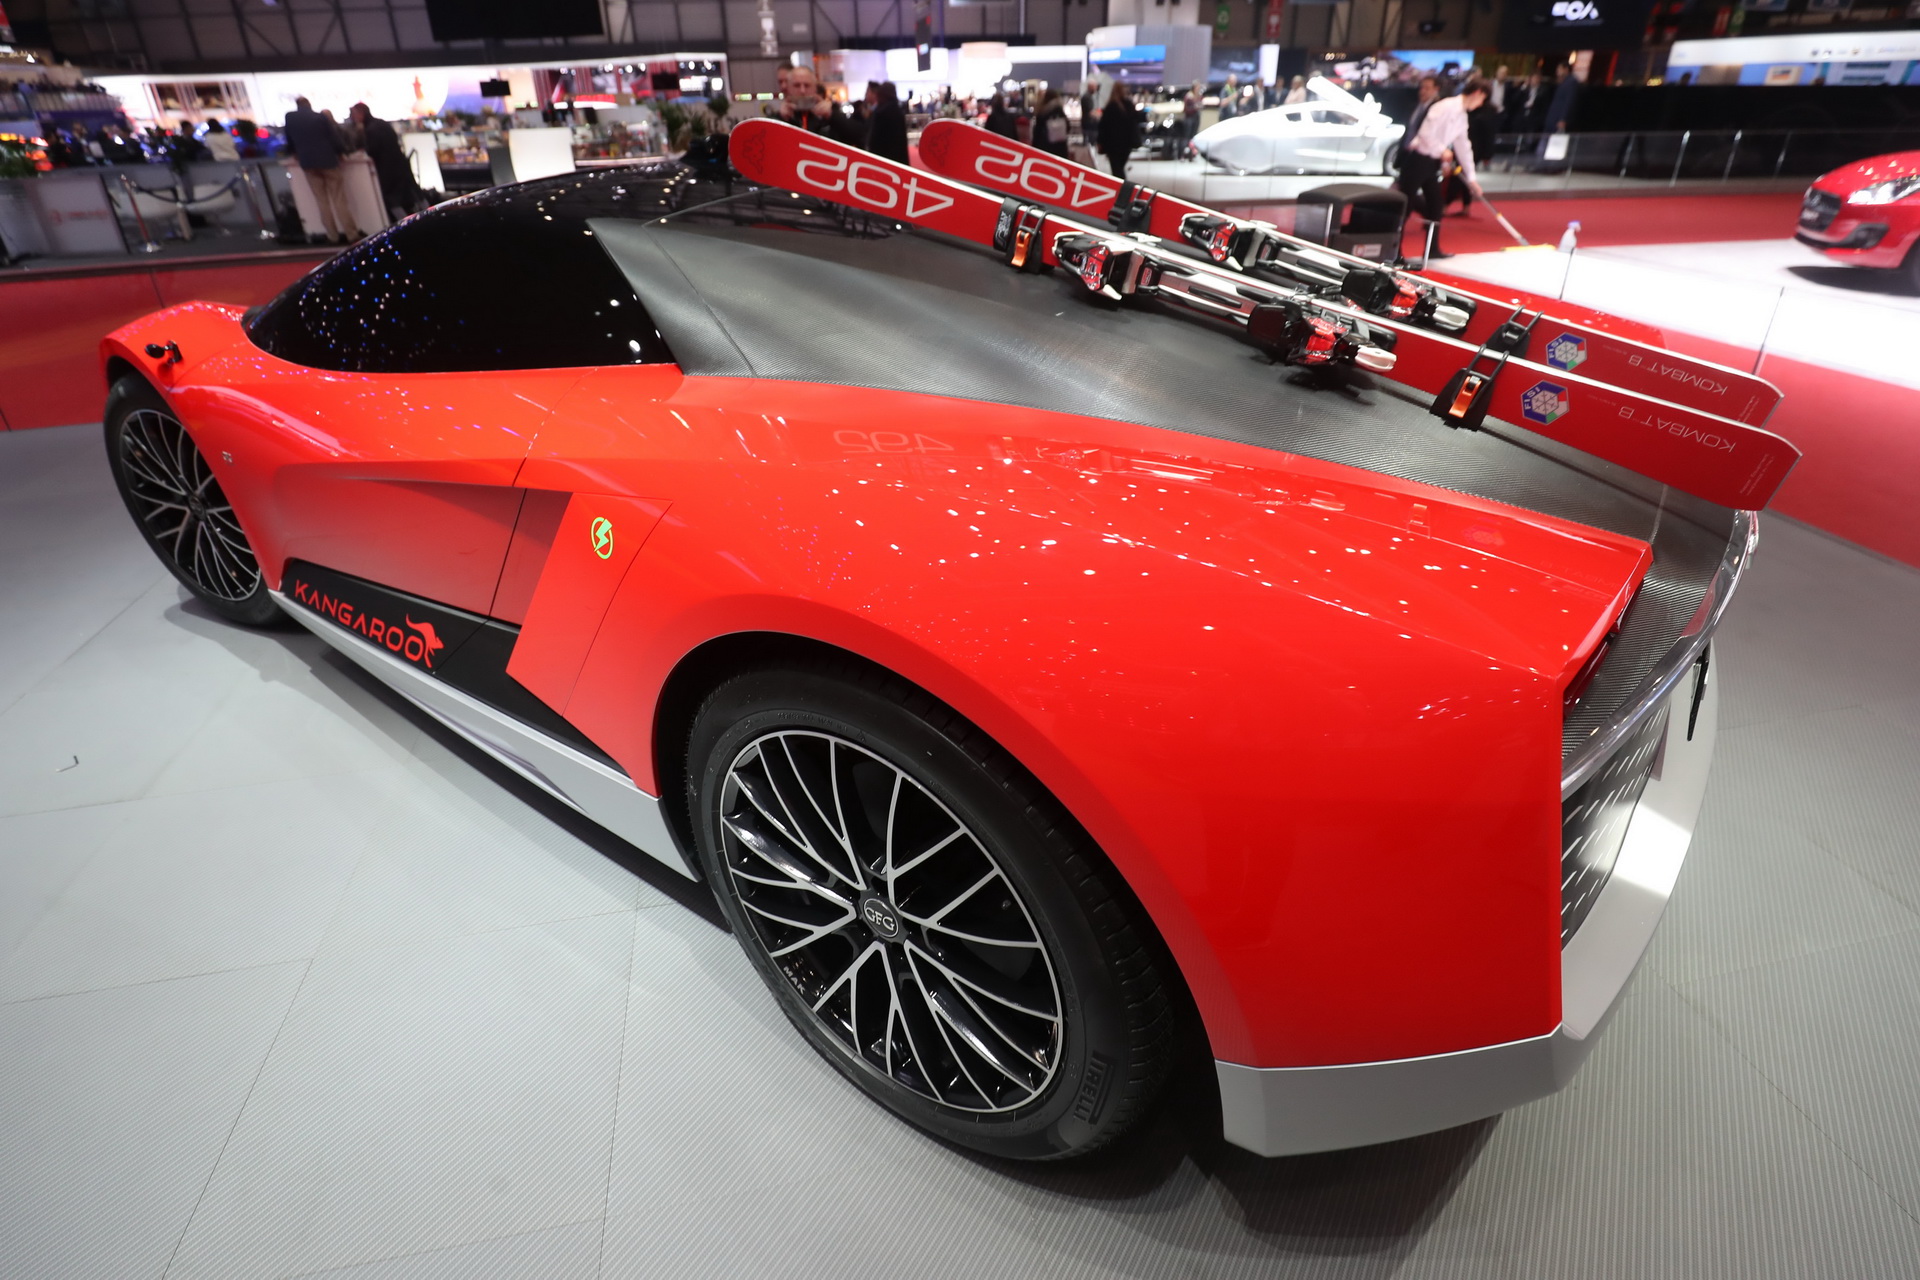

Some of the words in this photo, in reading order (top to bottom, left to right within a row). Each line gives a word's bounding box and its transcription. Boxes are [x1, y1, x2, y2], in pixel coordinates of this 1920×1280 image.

[796, 142, 954, 218] 492
[974, 140, 1117, 209] 492
[295, 580, 425, 662] KANGAROO
[865, 907, 895, 931] GFG
[783, 966, 806, 995] MAK
